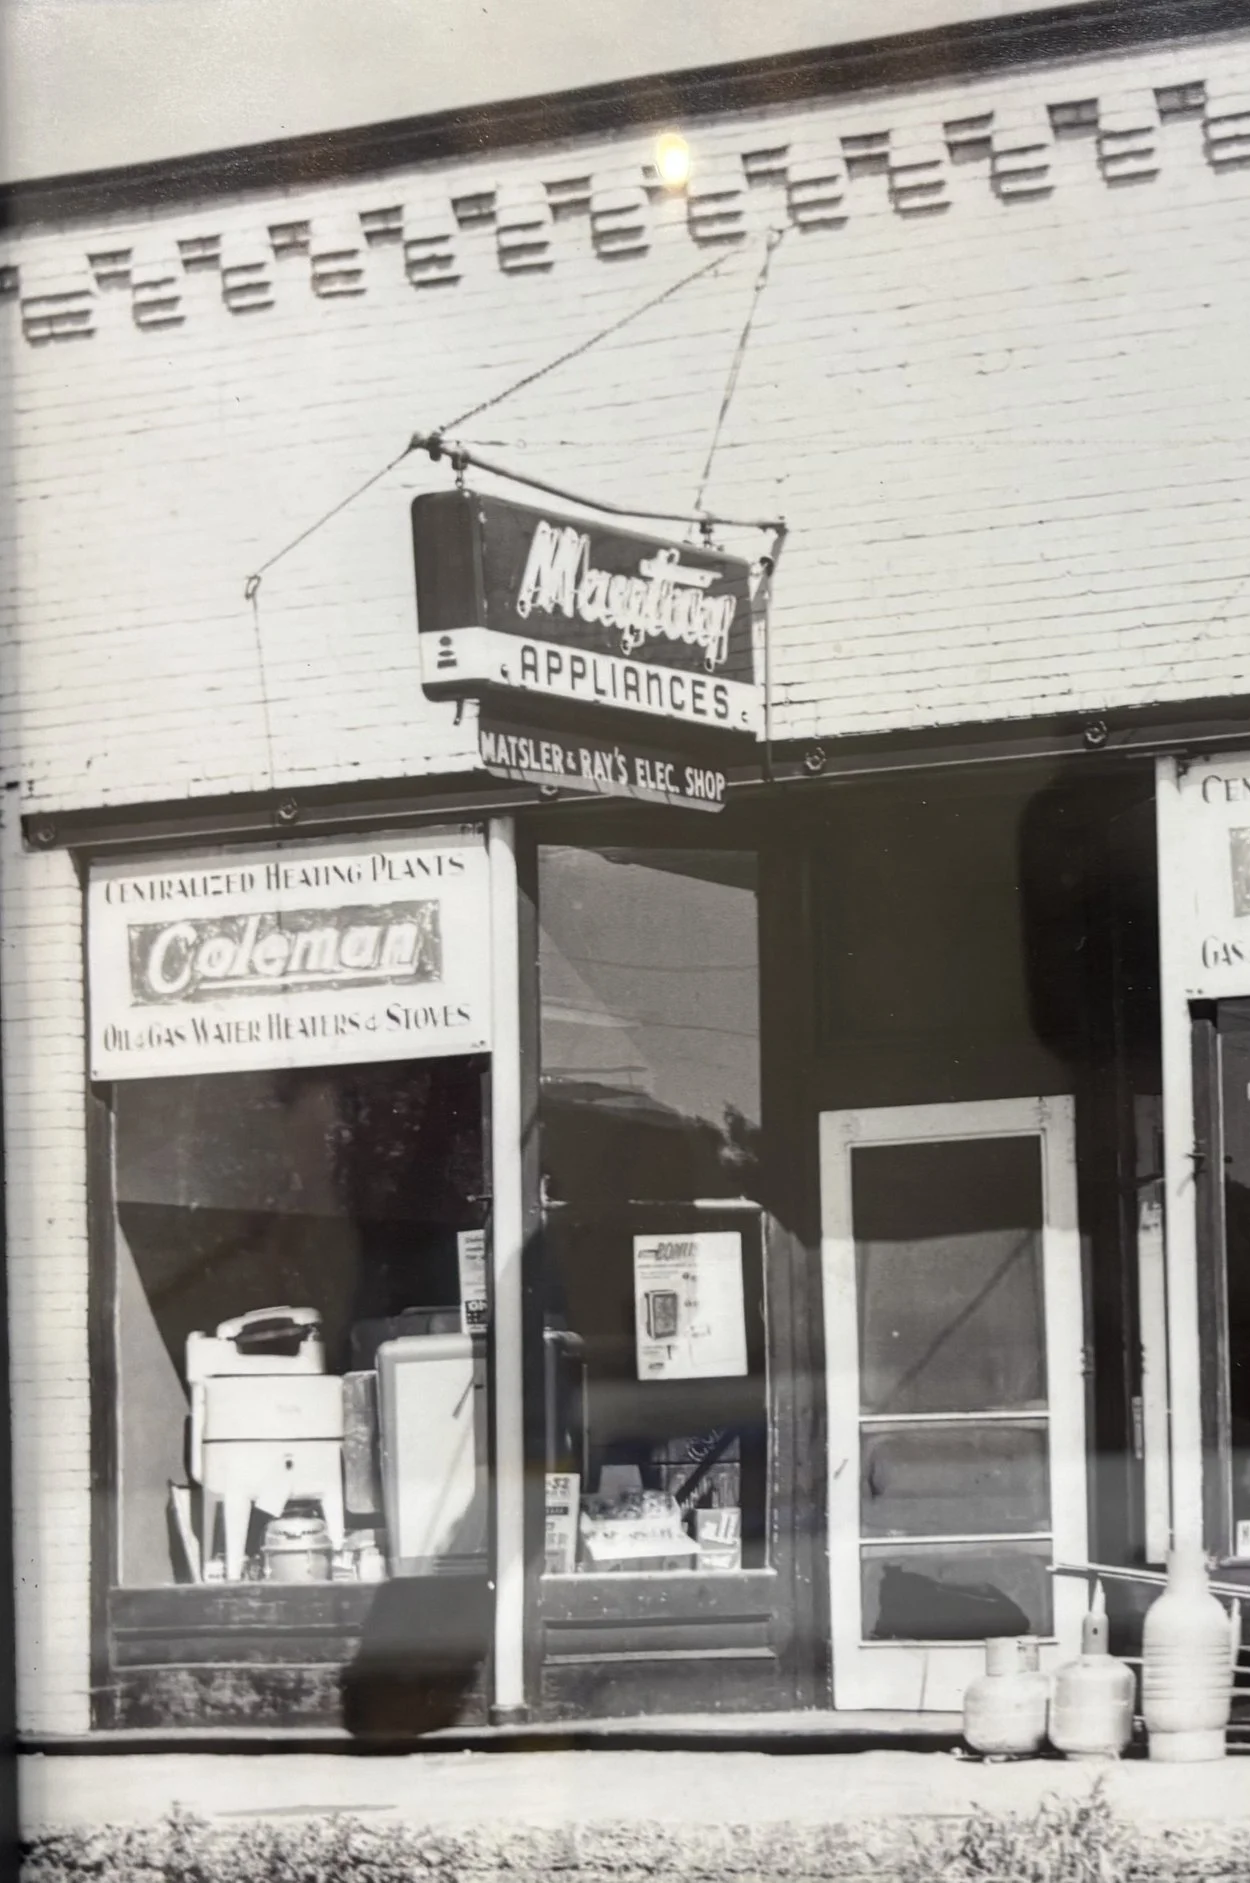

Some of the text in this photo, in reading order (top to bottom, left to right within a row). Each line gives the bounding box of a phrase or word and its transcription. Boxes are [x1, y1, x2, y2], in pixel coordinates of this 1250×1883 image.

[517, 520, 737, 673] Maytag
[520, 644, 731, 721] APPLIANCES
[480, 730, 727, 802] MATSLER & RAY'S ELEC. SHOP
[105, 852, 466, 905] CENTRALIZED HEATING PLANTS
[147, 912, 422, 996] Coleman
[103, 1023, 131, 1052] OIL
[191, 1016, 262, 1046] WATER
[267, 1011, 361, 1042] HEATERS
[385, 1003, 472, 1032] STOVES
